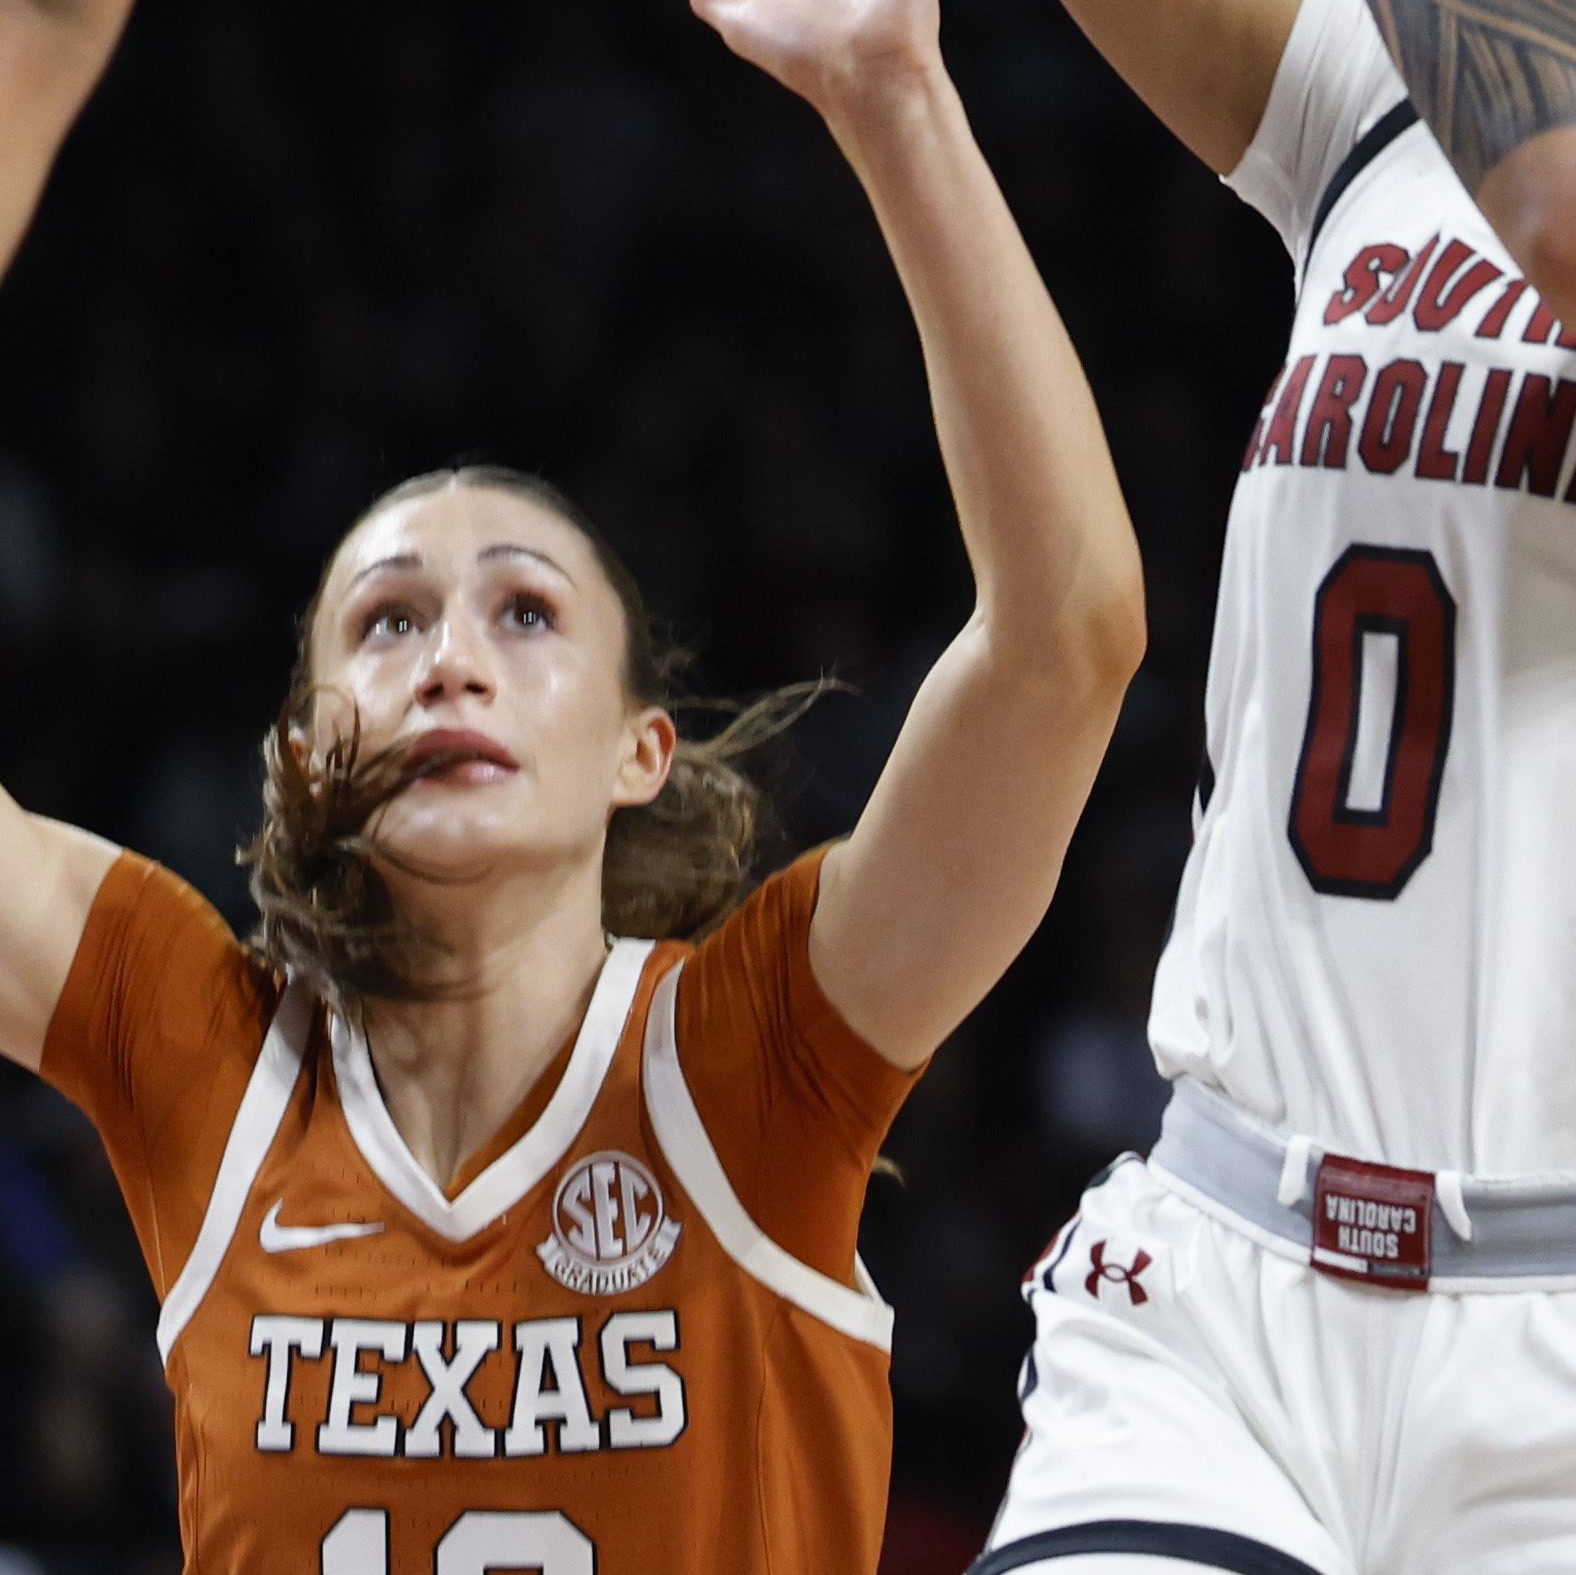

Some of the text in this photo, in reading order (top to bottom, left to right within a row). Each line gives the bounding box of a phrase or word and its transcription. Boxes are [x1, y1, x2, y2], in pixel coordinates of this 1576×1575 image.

[1286, 542, 1457, 902] 0
[562, 1161, 652, 1260] SEC
[1325, 1193, 1417, 1235] CAROLINA
[1338, 1224, 1399, 1259] SOUTH
[249, 1310, 688, 1458] TEXAS
